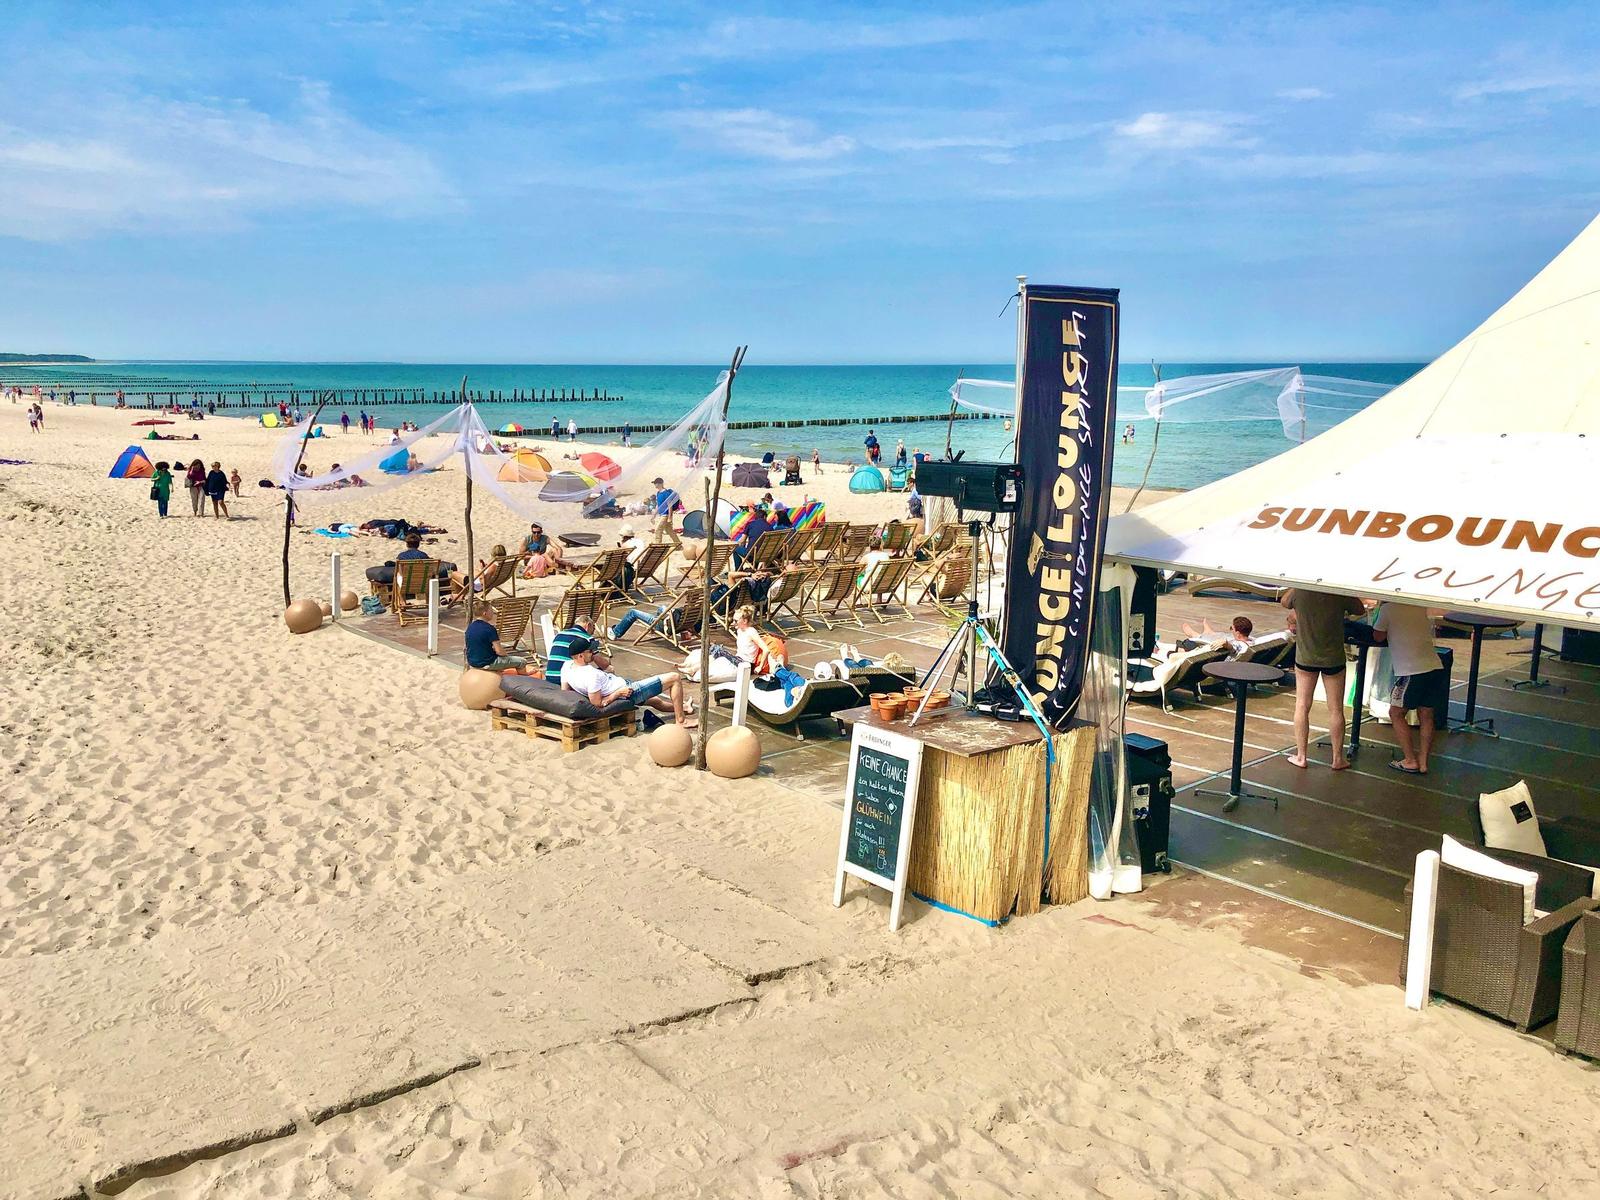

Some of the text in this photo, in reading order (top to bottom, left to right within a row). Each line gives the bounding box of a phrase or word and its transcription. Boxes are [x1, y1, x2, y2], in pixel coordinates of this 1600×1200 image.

[859, 751, 907, 784] KEINE CHANCE
[856, 800, 893, 826] GLÜHWEIN
